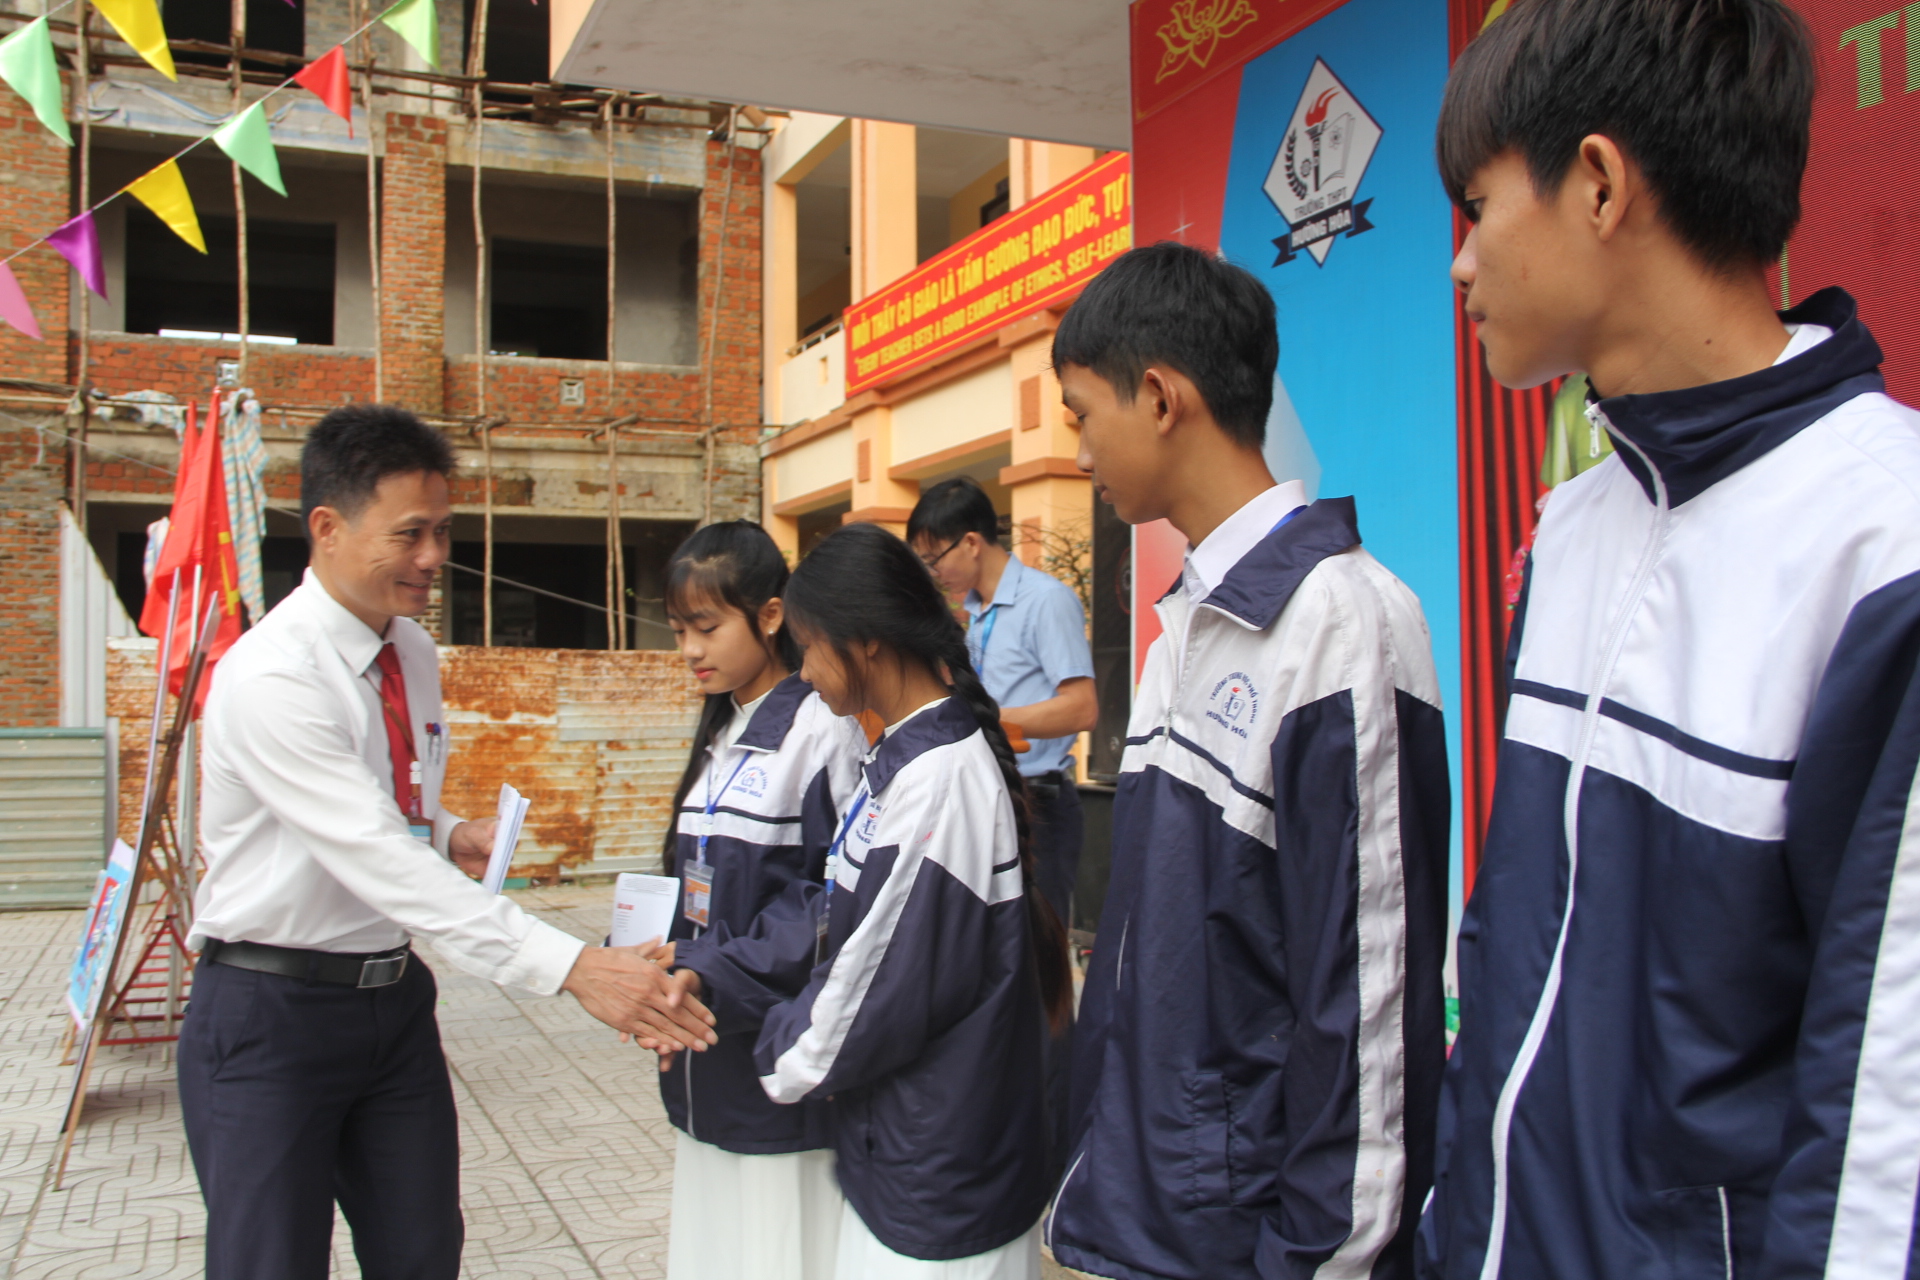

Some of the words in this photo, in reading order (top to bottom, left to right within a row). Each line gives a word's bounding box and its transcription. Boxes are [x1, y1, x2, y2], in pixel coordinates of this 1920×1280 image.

[940, 267, 956, 305] LÀ
[1102, 172, 1126, 220] TỰ
[967, 285, 1010, 325] EXAMPLE
[1011, 278, 1024, 303] OF
